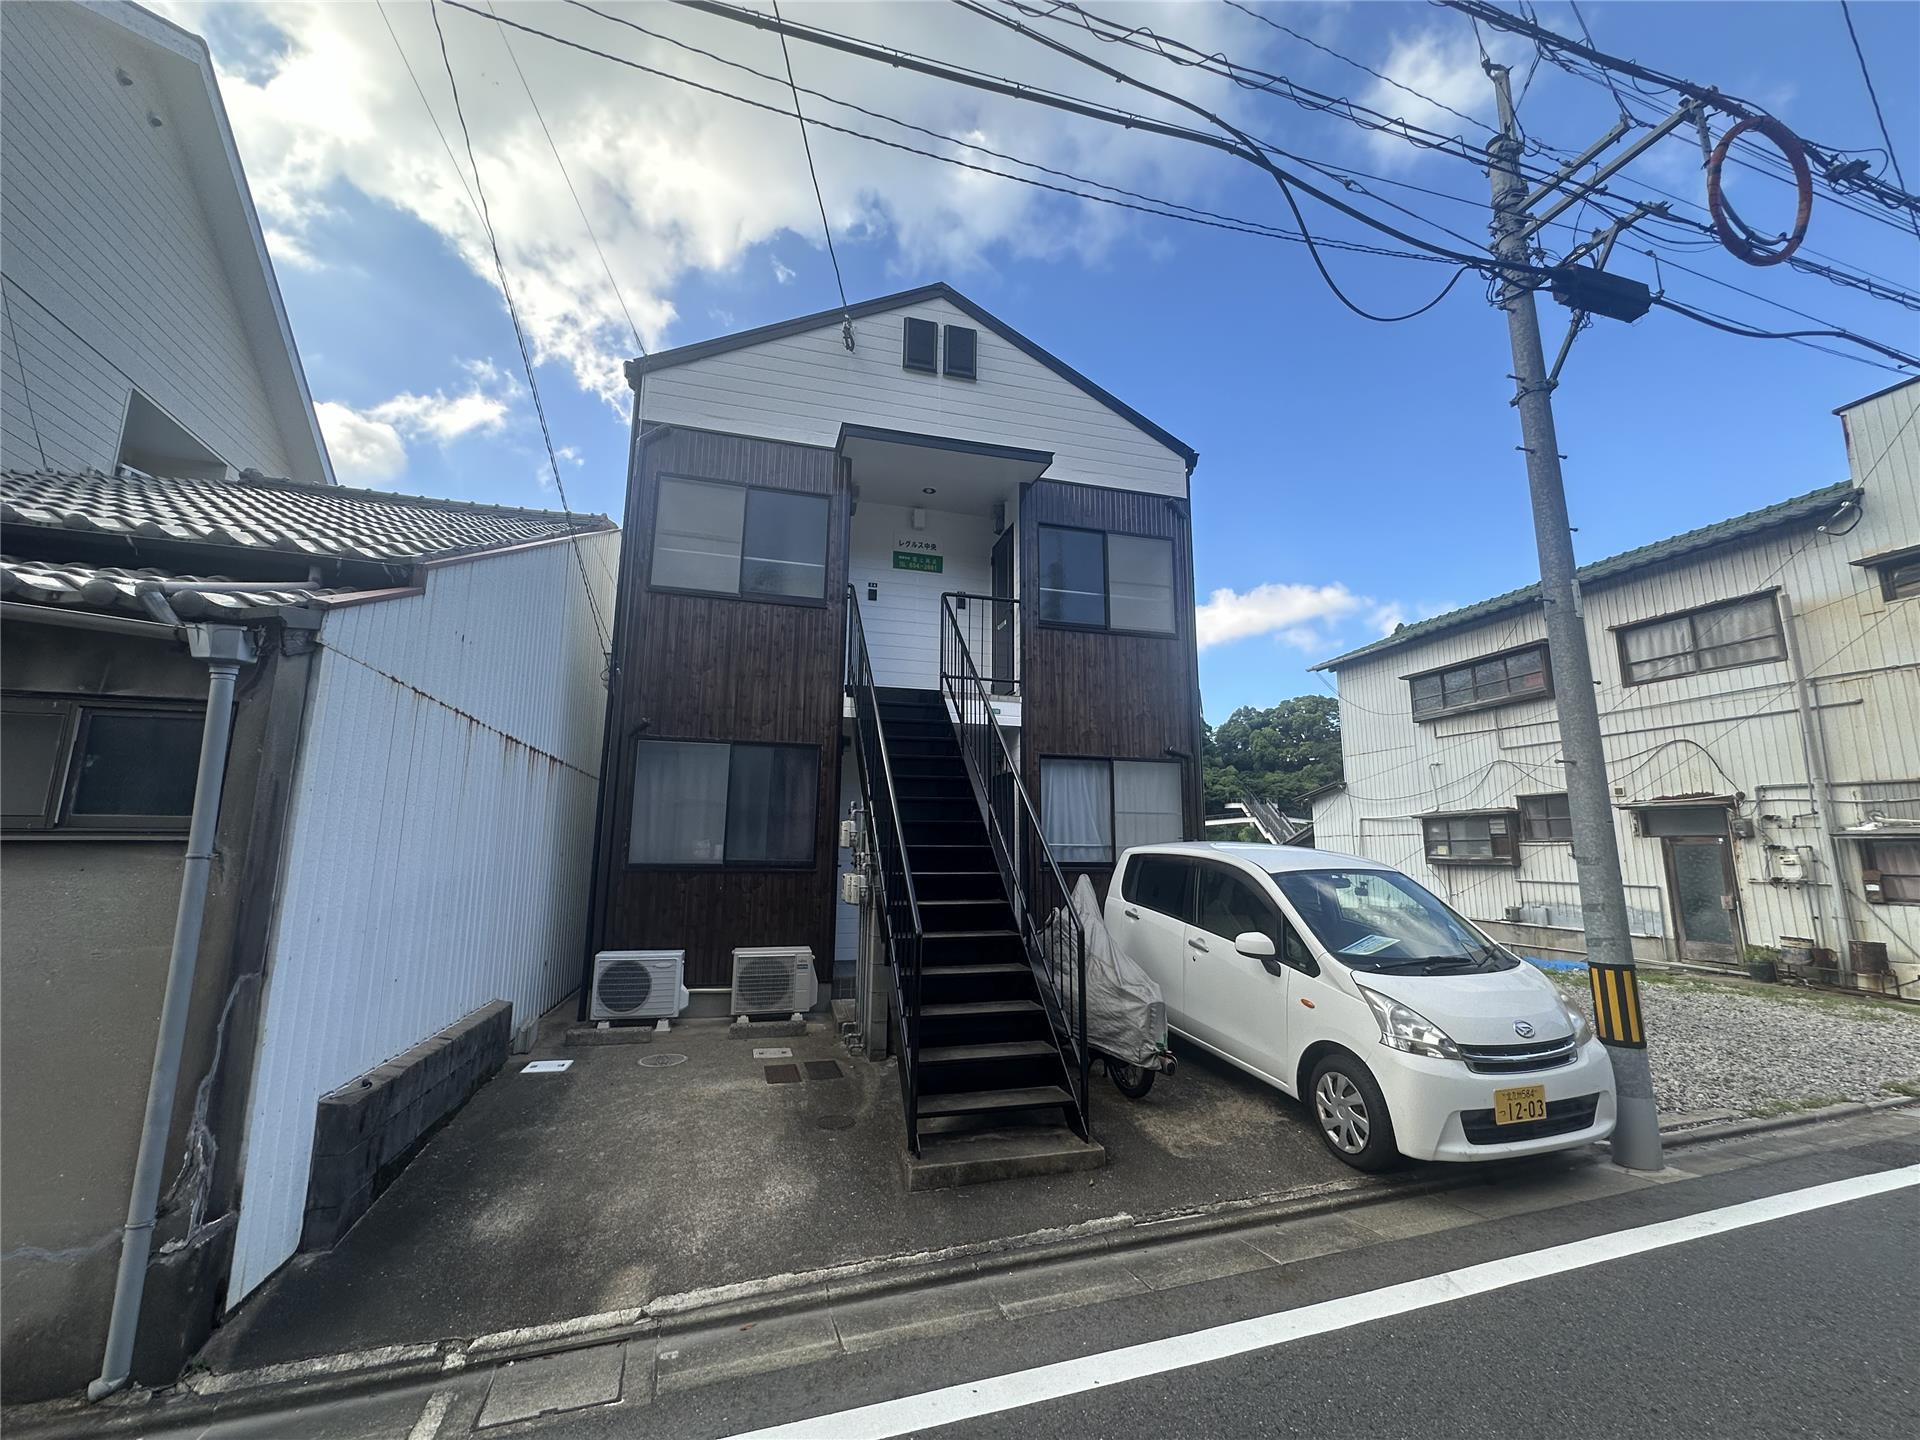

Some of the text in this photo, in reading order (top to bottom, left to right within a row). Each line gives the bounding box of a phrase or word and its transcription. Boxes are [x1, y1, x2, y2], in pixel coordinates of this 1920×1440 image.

[898, 539, 937, 551] レグルス中央
[1508, 1099, 1544, 1121] 12-03
